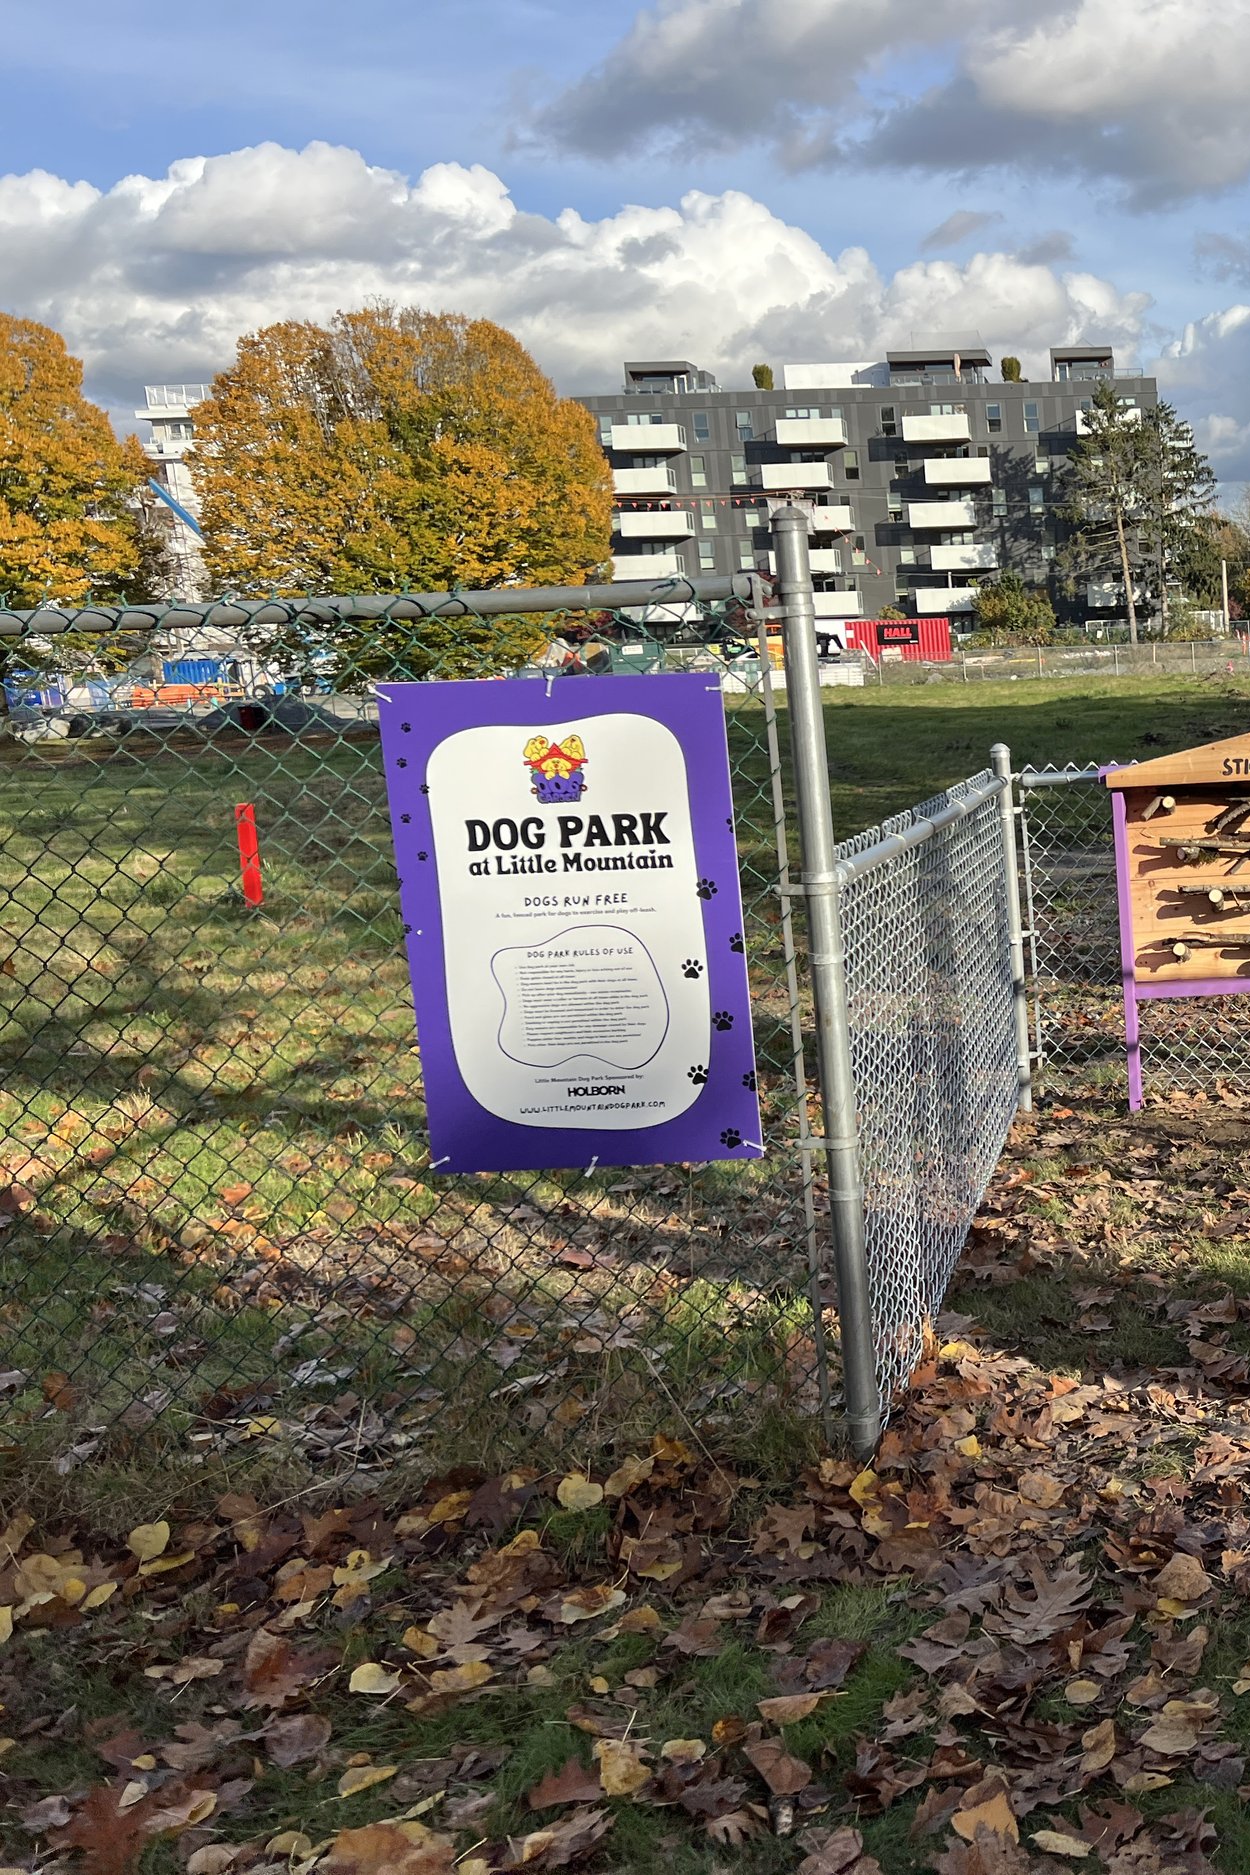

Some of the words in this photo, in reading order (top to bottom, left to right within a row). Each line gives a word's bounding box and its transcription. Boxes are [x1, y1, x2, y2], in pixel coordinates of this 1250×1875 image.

[884, 627, 912, 637] HALL
[465, 816, 546, 852] DOG
[558, 812, 671, 848] PARK
[469, 858, 491, 876] at
[495, 854, 558, 876] Little
[562, 849, 674, 873] Mountain
[524, 896, 559, 907] DOGS
[564, 895, 590, 907] RUN
[596, 893, 628, 906] FREE
[547, 949, 570, 958] PARK
[573, 949, 600, 958] RULES
[618, 947, 633, 955] USE
[568, 1085, 625, 1097] HOLBORN
